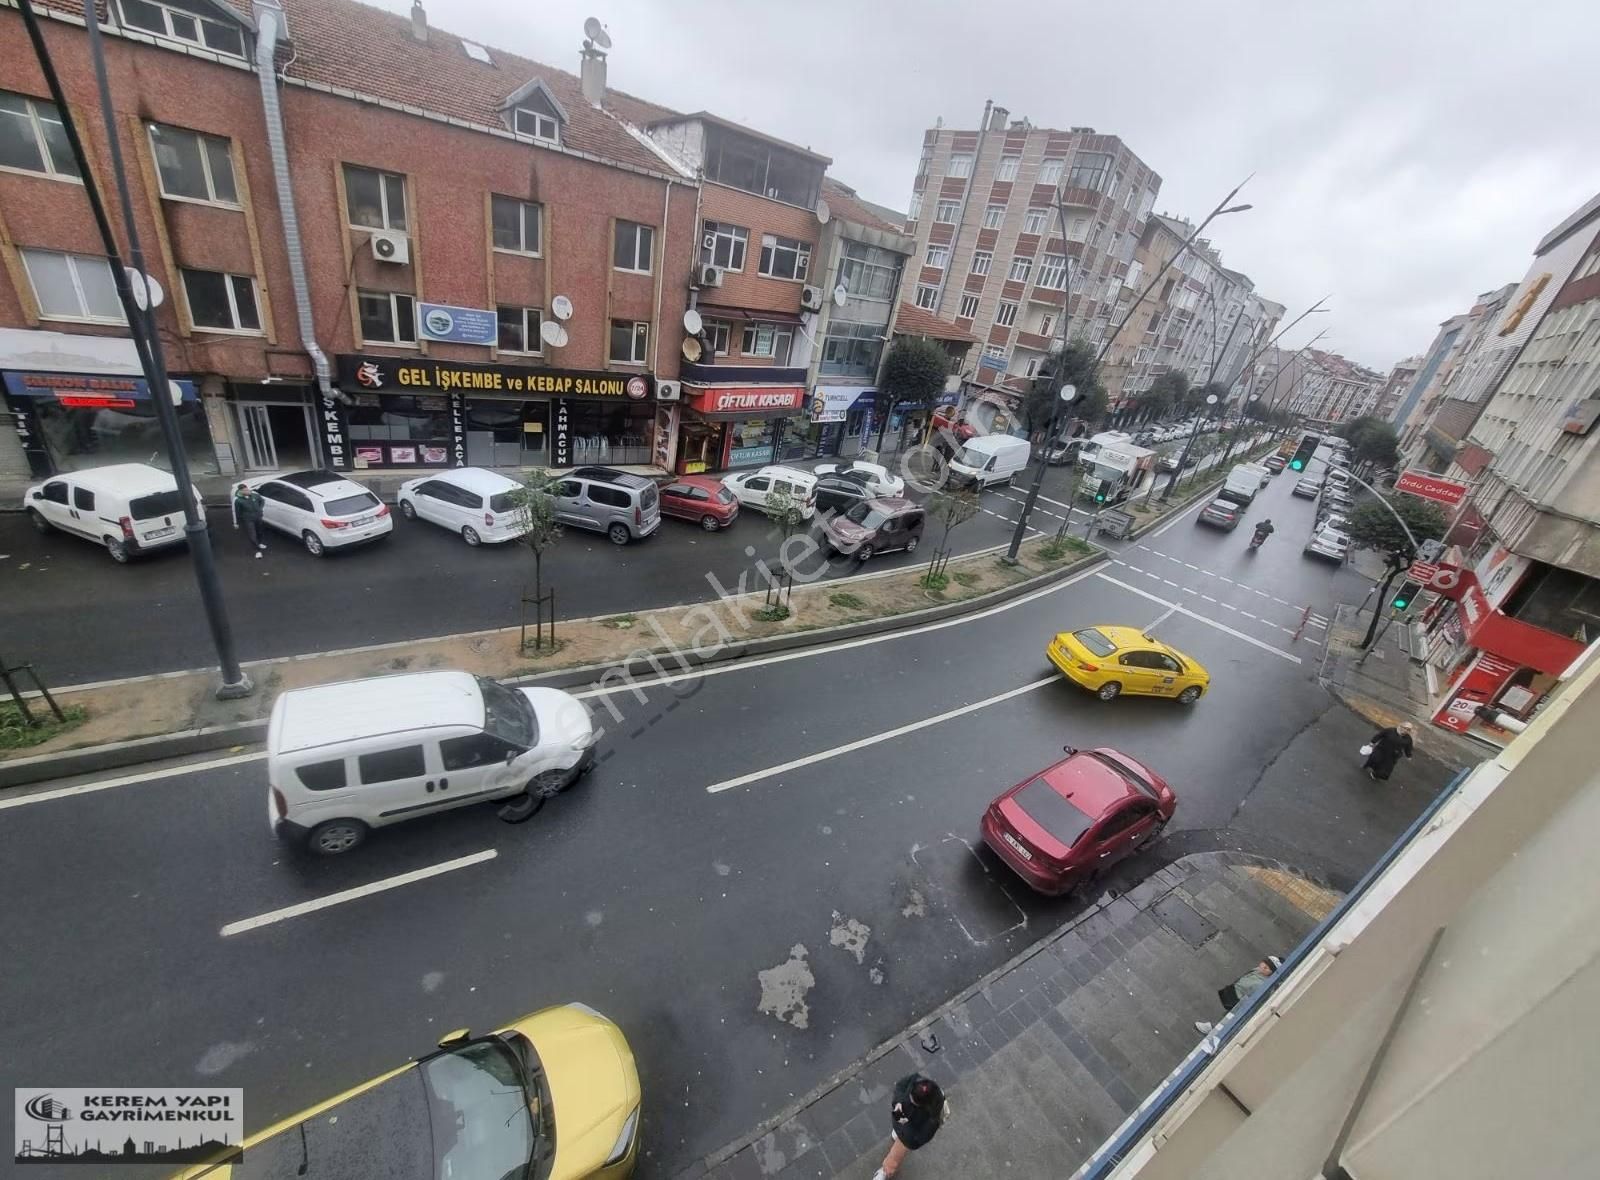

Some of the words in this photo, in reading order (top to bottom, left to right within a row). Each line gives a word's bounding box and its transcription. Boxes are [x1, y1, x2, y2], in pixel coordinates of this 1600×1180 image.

[398, 367, 431, 386] GEL
[435, 365, 502, 391] İŞKEMBE
[507, 378, 523, 390] ve
[527, 376, 572, 392] KEBAP
[575, 379, 624, 395] SALONU
[452, 393, 463, 433] KELLE
[717, 392, 756, 411] ÇİFTLİK
[758, 393, 794, 407] KASABI
[323, 398, 345, 466] ŞKEMBE
[557, 398, 568, 464] LAHMACUN
[455, 436, 464, 467] PAÇA
[1400, 479, 1423, 489] Ordu
